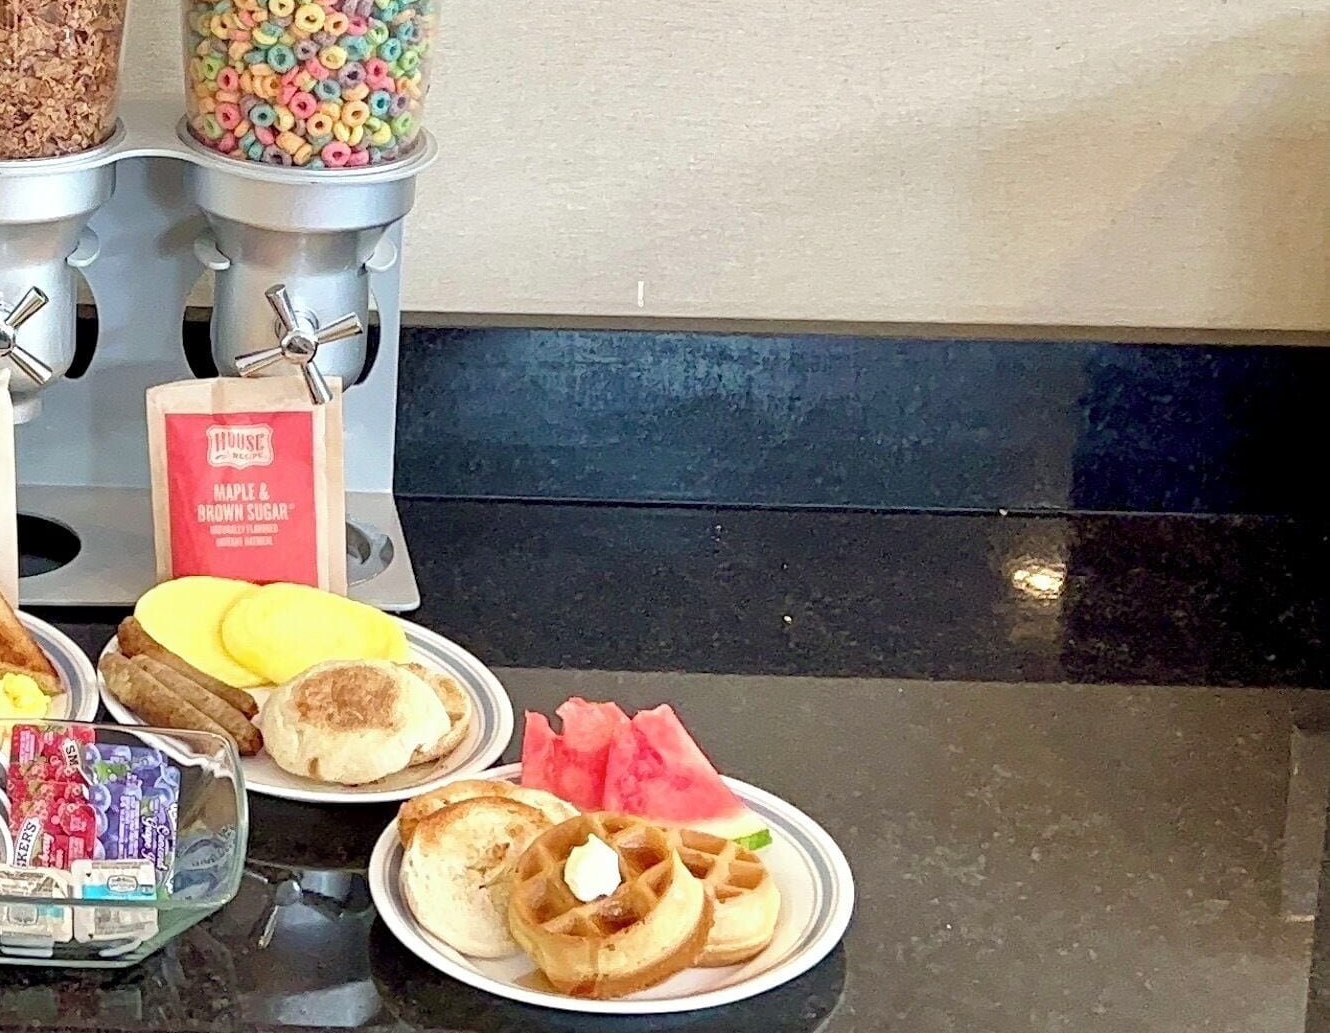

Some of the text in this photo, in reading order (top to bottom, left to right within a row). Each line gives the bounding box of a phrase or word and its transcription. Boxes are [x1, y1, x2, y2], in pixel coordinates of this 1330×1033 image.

[215, 431, 265, 452] HOUSE
[213, 481, 270, 501] MAPLE &
[197, 502, 289, 522] BROWN SUGAR
[65, 744, 79, 767] SM
